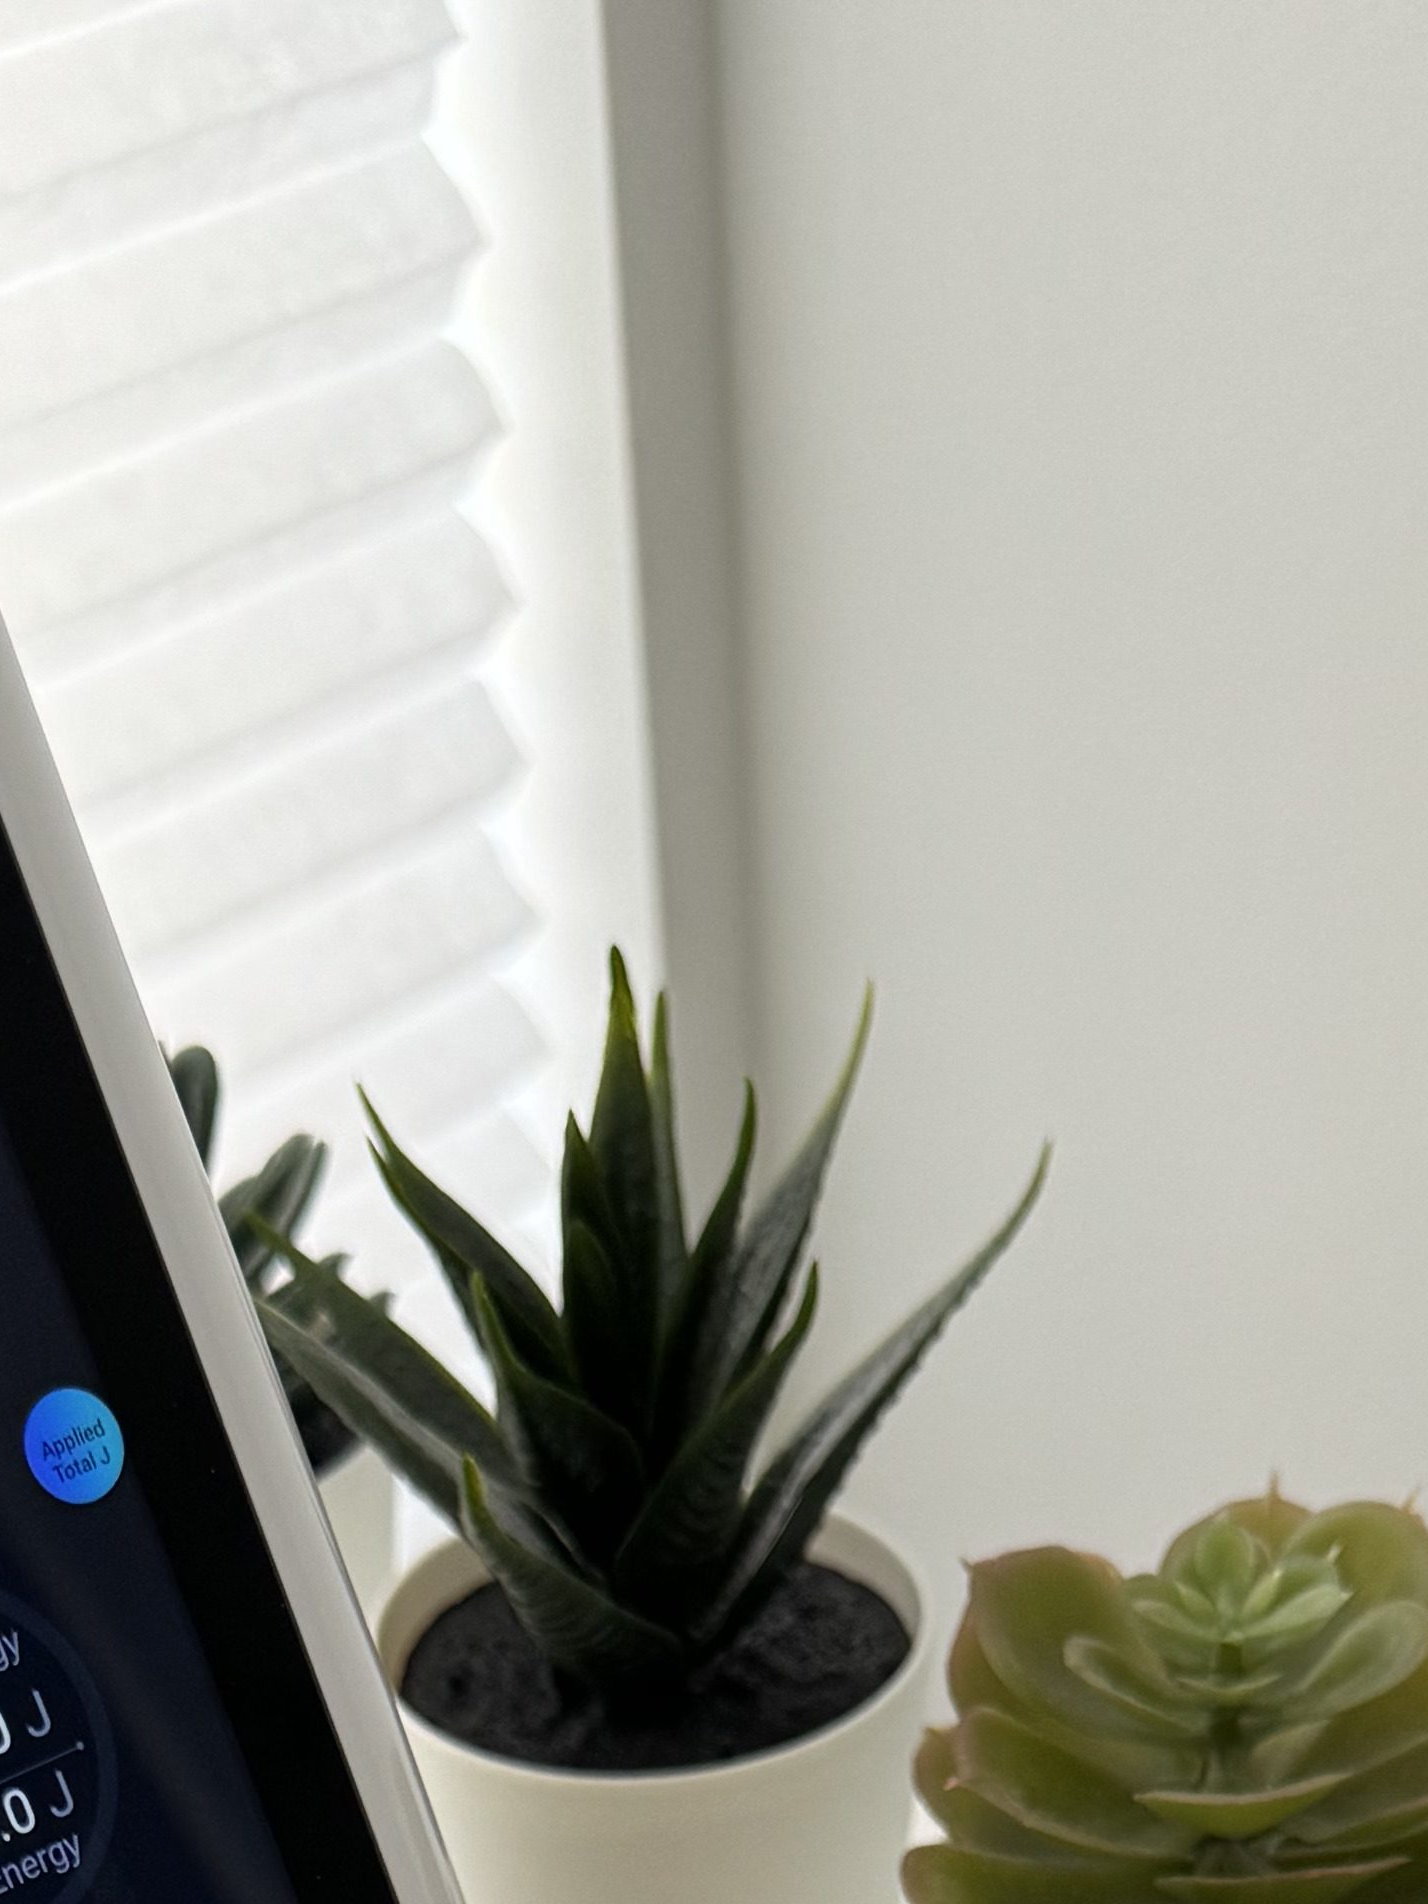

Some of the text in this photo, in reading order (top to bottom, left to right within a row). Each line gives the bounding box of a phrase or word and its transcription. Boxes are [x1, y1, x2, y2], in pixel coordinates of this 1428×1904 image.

[42, 1419, 106, 1465] Applied
[51, 1445, 112, 1485] Total J
[25, 1688, 53, 1739] J
[49, 1769, 76, 1819] J
